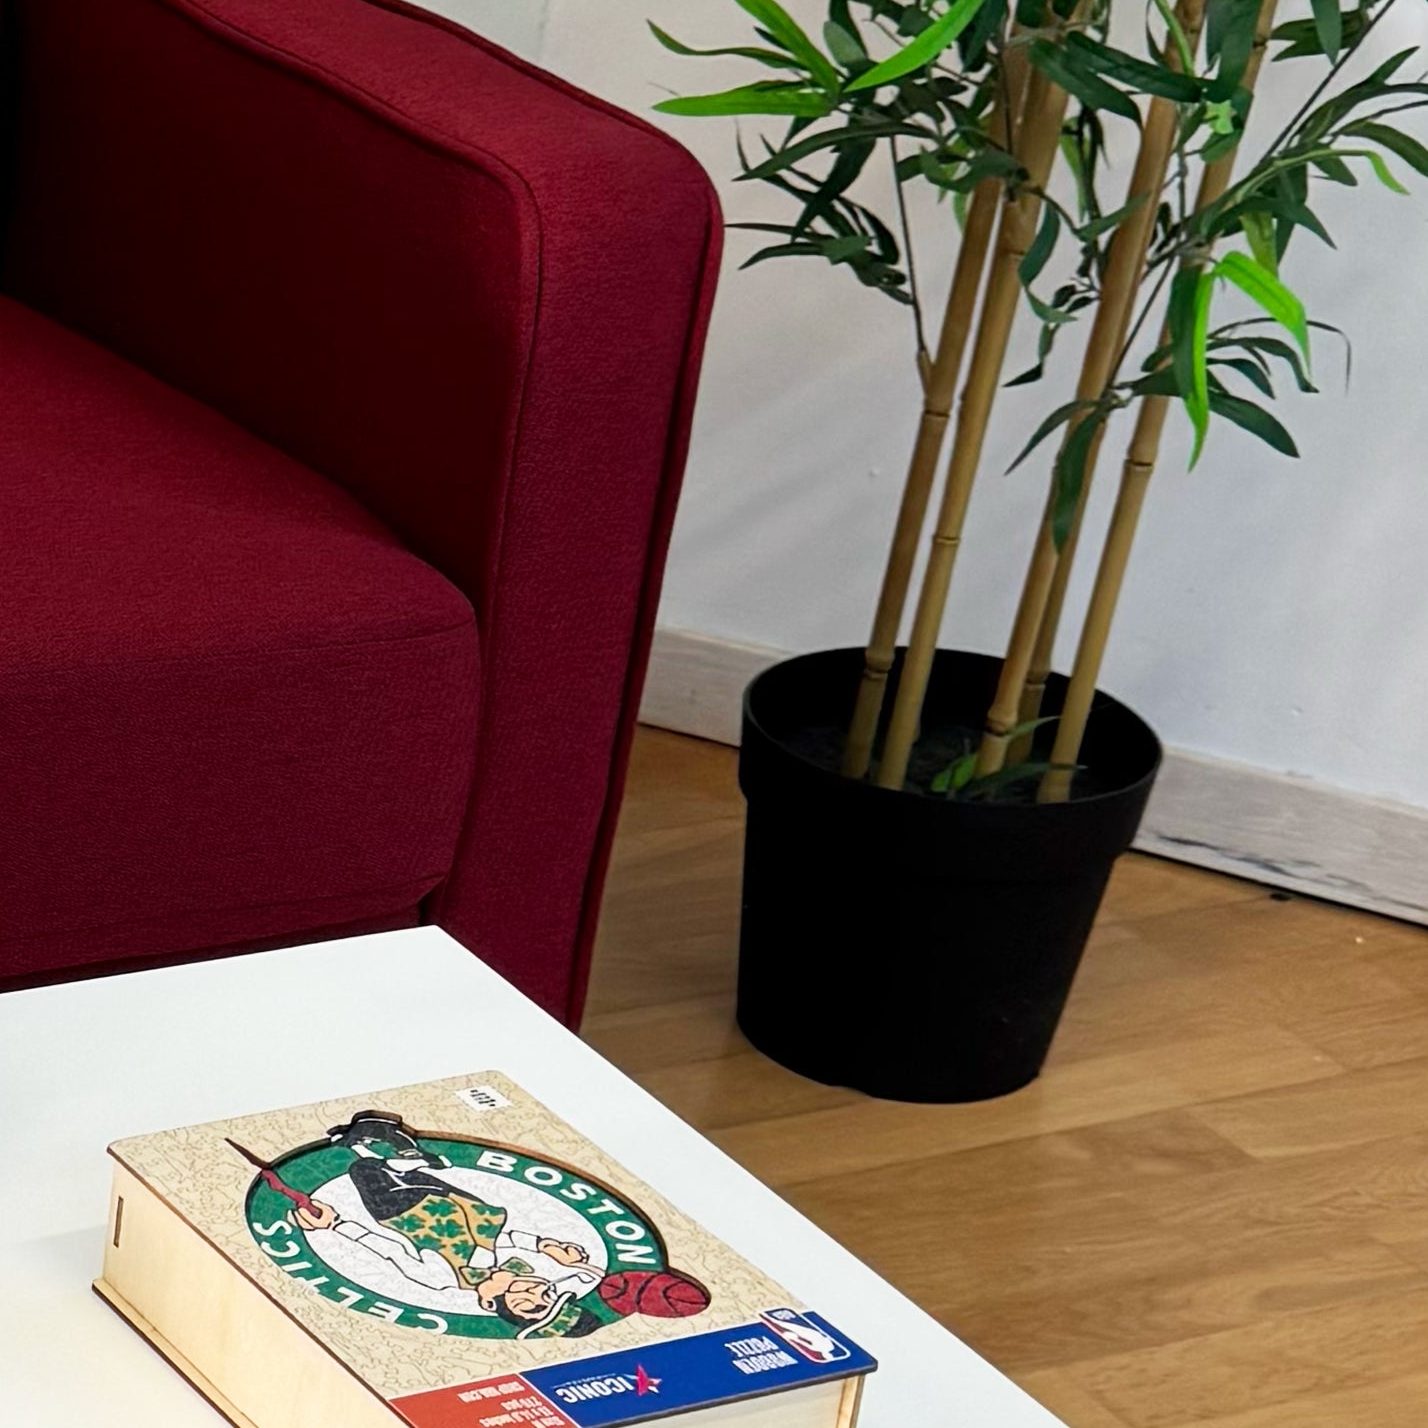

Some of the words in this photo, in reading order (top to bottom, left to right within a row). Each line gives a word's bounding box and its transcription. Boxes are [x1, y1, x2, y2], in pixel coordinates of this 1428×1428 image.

[475, 1150, 656, 1265] BOSTON
[253, 1220, 448, 1336] CELTICS
[724, 1335, 780, 1358] PUZZLE
[732, 1350, 799, 1375] WOODEN
[555, 1376, 635, 1404] ICONIC
